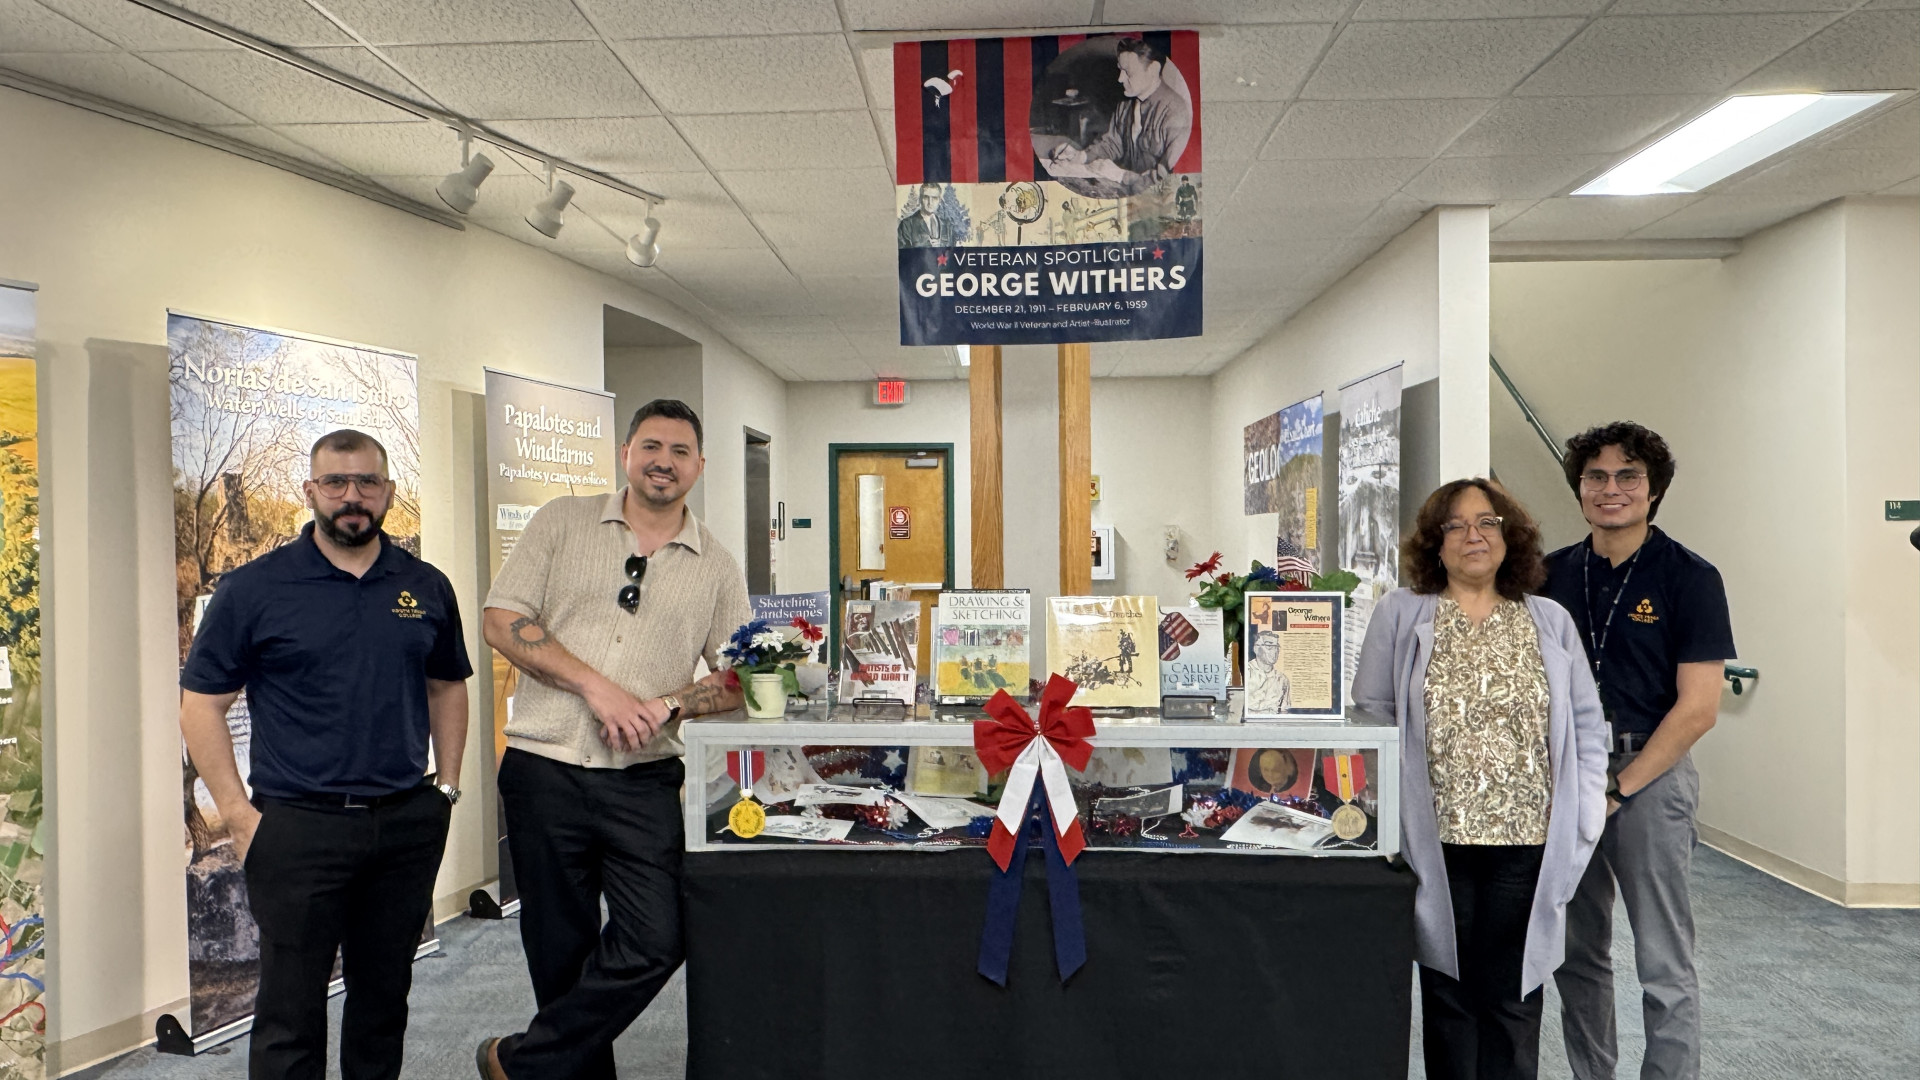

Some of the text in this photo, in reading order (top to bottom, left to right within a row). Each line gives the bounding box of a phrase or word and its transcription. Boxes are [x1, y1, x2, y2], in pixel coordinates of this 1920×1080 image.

[953, 246, 1147, 266] VETERAN SPOTLIGHT
[915, 265, 1187, 297] GEORGE WITHERS
[954, 305, 1012, 314] DECEMBER
[1014, 304, 1027, 314] 21,
[1028, 304, 1047, 313] 1911
[1056, 302, 1112, 312] FEBRUARY
[1114, 301, 1124, 311] 6,
[1125, 300, 1148, 309] 1959
[970, 321, 995, 330] World
[996, 321, 1012, 330] War
[1019, 320, 1051, 329] Veteran
[1052, 320, 1068, 329] and
[184, 353, 410, 410] Norias de San Isidro
[878, 381, 905, 404] EXIT
[207, 392, 395, 430] Water Wells of San Isidro
[504, 404, 603, 438] Papalotes and
[515, 436, 594, 466] Windfarms
[499, 463, 542, 483] Papalotes
[542, 471, 550, 487] y
[550, 472, 582, 488] campos
[752, 597, 823, 620] Sketching Landscapes
[949, 596, 1025, 607] DRAWING &
[952, 609, 1022, 619] SKETCHING
[1162, 674, 1220, 684] TO SERVE
[1171, 663, 1220, 674] CALLED
